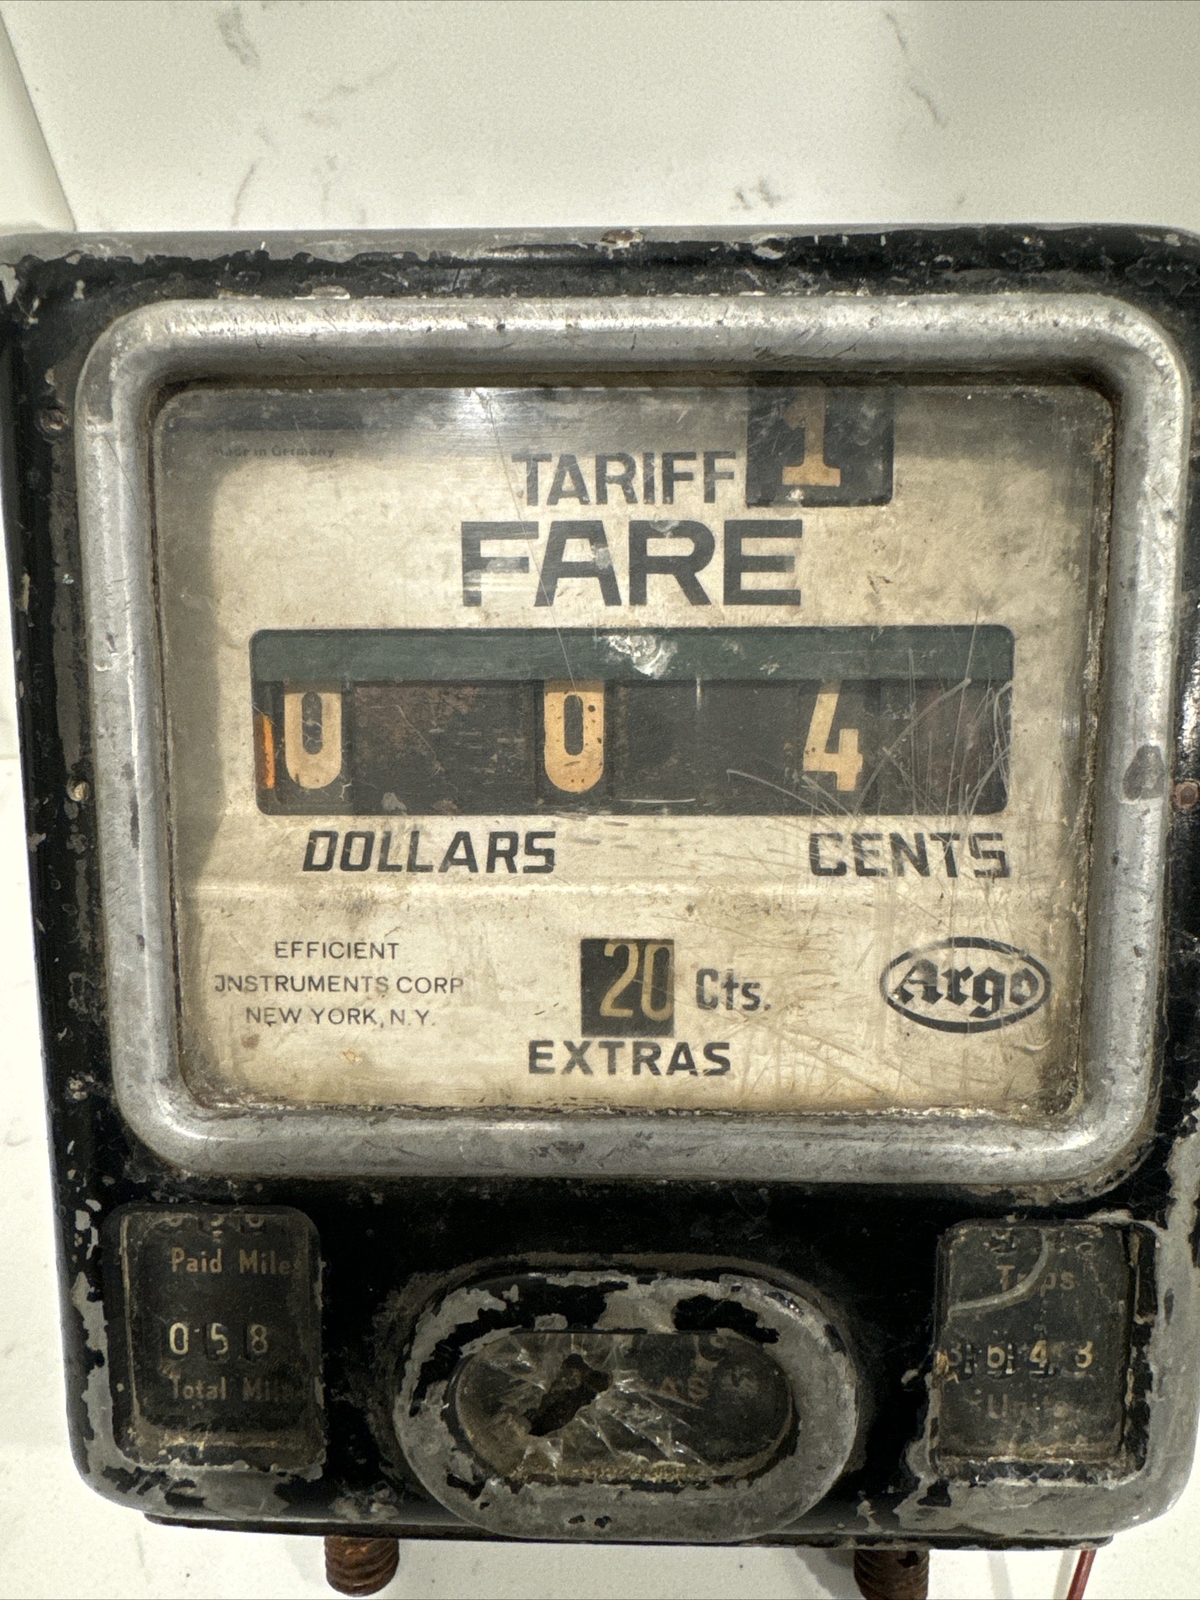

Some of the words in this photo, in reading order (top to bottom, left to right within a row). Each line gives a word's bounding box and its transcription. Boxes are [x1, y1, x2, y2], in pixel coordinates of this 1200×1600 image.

[271, 444, 336, 459] Germany
[511, 451, 737, 506] TARIFF
[780, 386, 842, 487] 1
[461, 519, 803, 607] FARE
[802, 680, 863, 791] 4
[302, 830, 557, 874] DOLLARS
[809, 832, 1011, 879] CENTS
[274, 941, 400, 960] EFFICIENT
[395, 976, 465, 994] CORP
[600, 938, 675, 1022] 20
[695, 968, 772, 1012] Cts.
[892, 958, 1039, 1019] Argo
[246, 1006, 302, 1025] NEW
[310, 1007, 385, 1028] YORK,
[390, 1008, 436, 1027] N.Y.
[528, 1039, 731, 1077] EXTRAS
[171, 1248, 223, 1274] Paid
[996, 1264, 1076, 1297] Tps
[168, 1374, 226, 1401] Total
